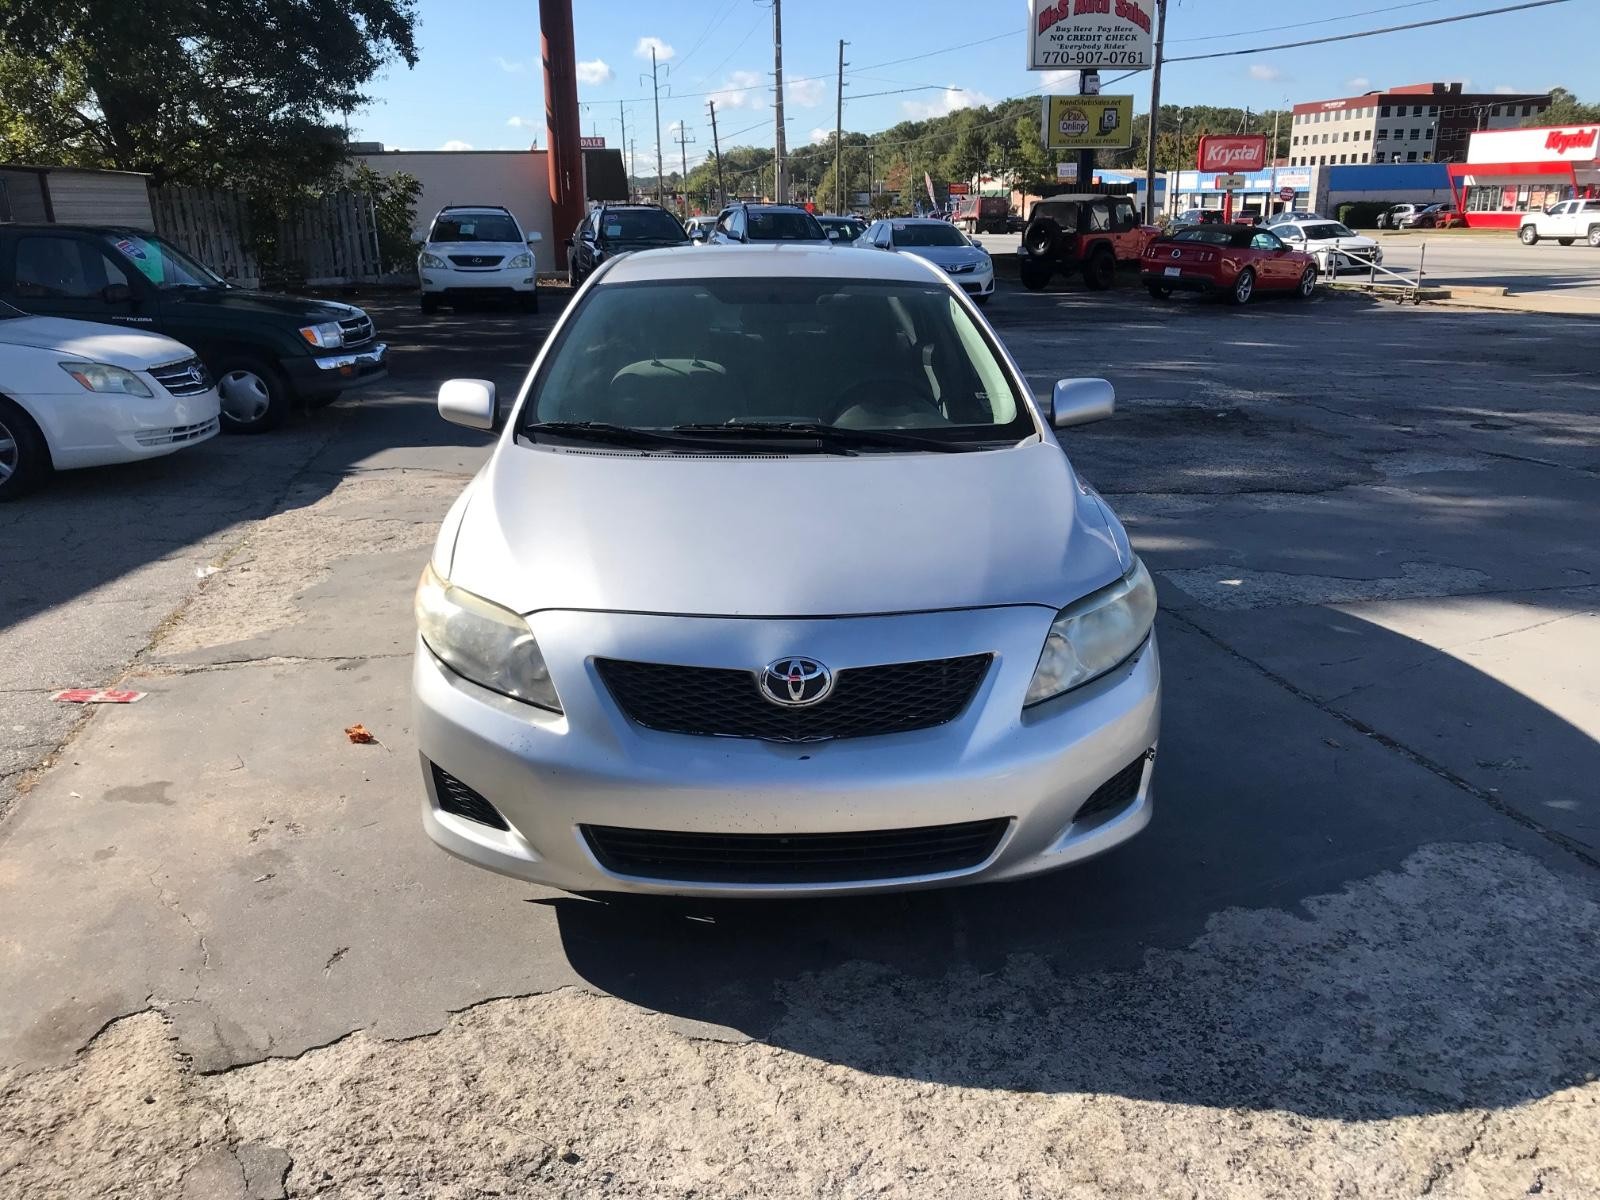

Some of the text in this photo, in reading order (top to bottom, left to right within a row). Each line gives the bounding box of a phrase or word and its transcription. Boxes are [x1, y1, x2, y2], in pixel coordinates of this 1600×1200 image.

[1115, 0, 1151, 35] Sales
[1050, 34, 1138, 42] NO CREDIT CHECK
[1042, 51, 1144, 64] 770-907-0761
[580, 138, 603, 147] DALE
[1544, 128, 1597, 155] Krystal
[1206, 144, 1260, 166] Krystal
